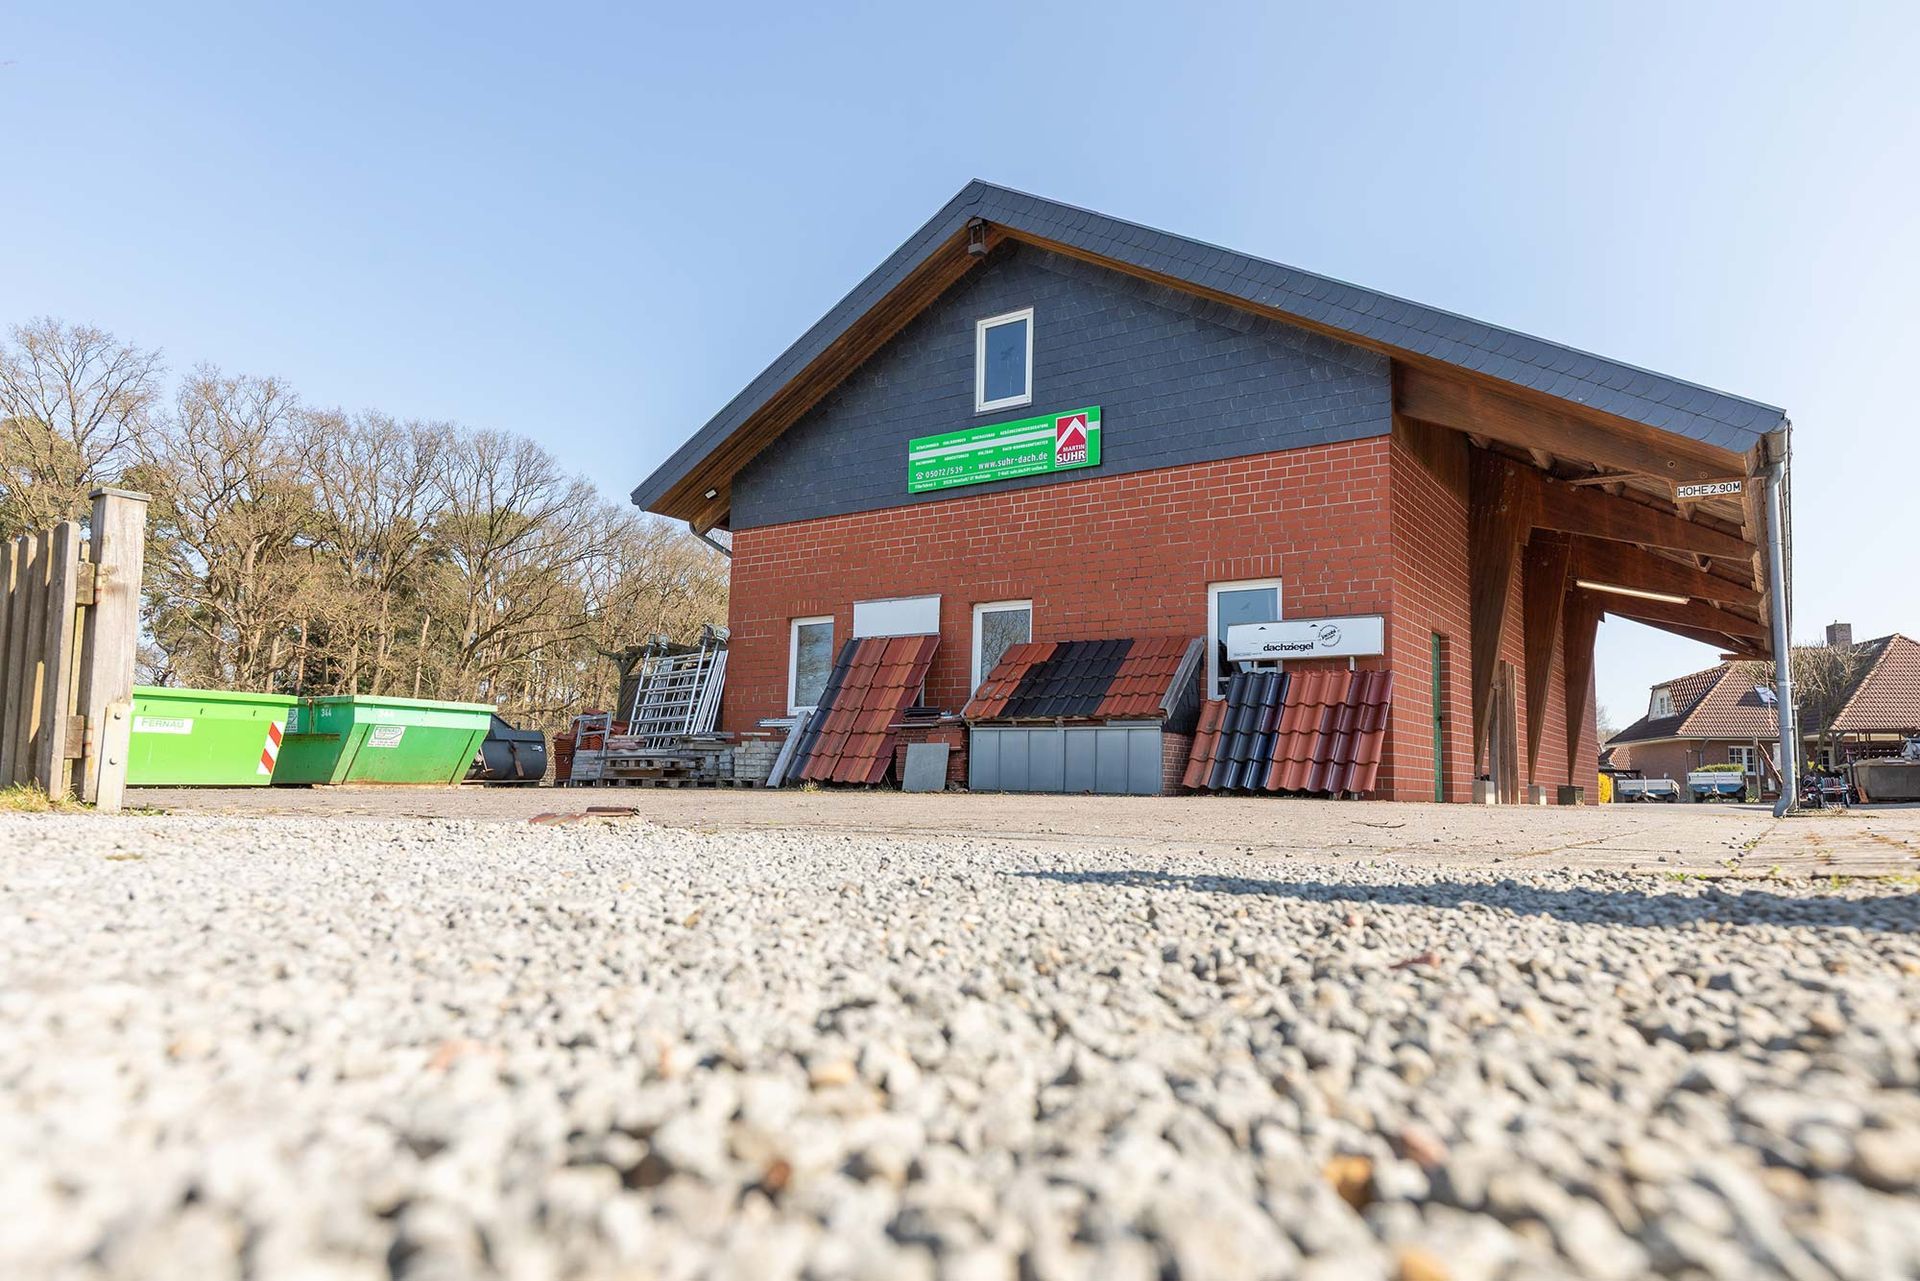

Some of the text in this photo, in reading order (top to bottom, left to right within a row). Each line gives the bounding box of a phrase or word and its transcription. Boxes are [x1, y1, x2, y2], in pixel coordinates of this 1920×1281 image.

[1063, 444, 1085, 452] MARTIN
[1057, 450, 1085, 462] SUHR
[925, 466, 963, 479] 05072/539
[978, 452, 1048, 469] www.suhr-dach.de
[1263, 642, 1314, 652] dachziegel
[142, 718, 185, 728] FERNAU
